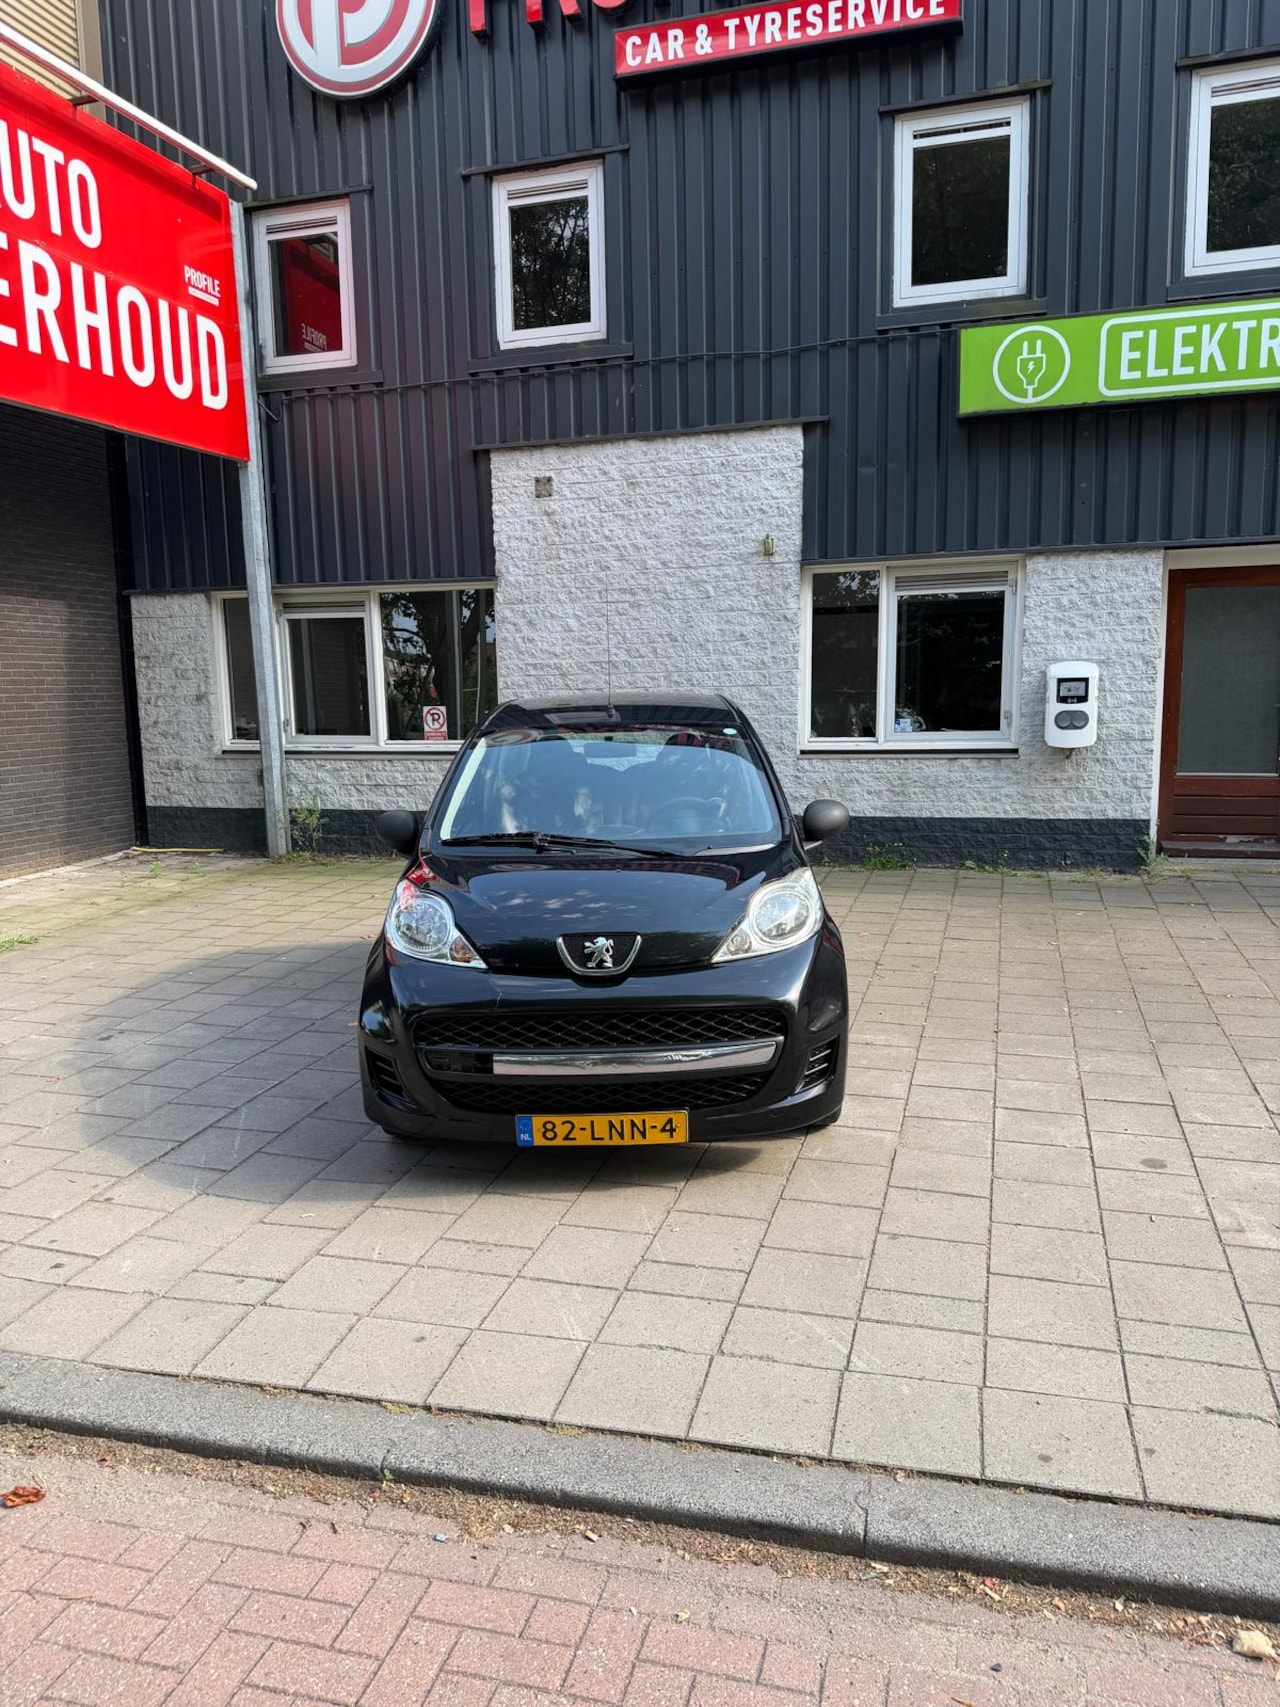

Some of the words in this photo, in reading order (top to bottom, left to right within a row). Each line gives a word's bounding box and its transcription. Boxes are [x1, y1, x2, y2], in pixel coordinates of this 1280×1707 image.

[625, 28, 685, 67] CAR
[695, 24, 714, 55] &
[723, 0, 945, 50] TYRESERVICE
[0, 118, 102, 249] UTO
[183, 264, 221, 298] PROFILE
[1119, 317, 1280, 381] ELEKTR
[520, 1133, 533, 1141] NL
[541, 1116, 677, 1142] 82-LNN-4
